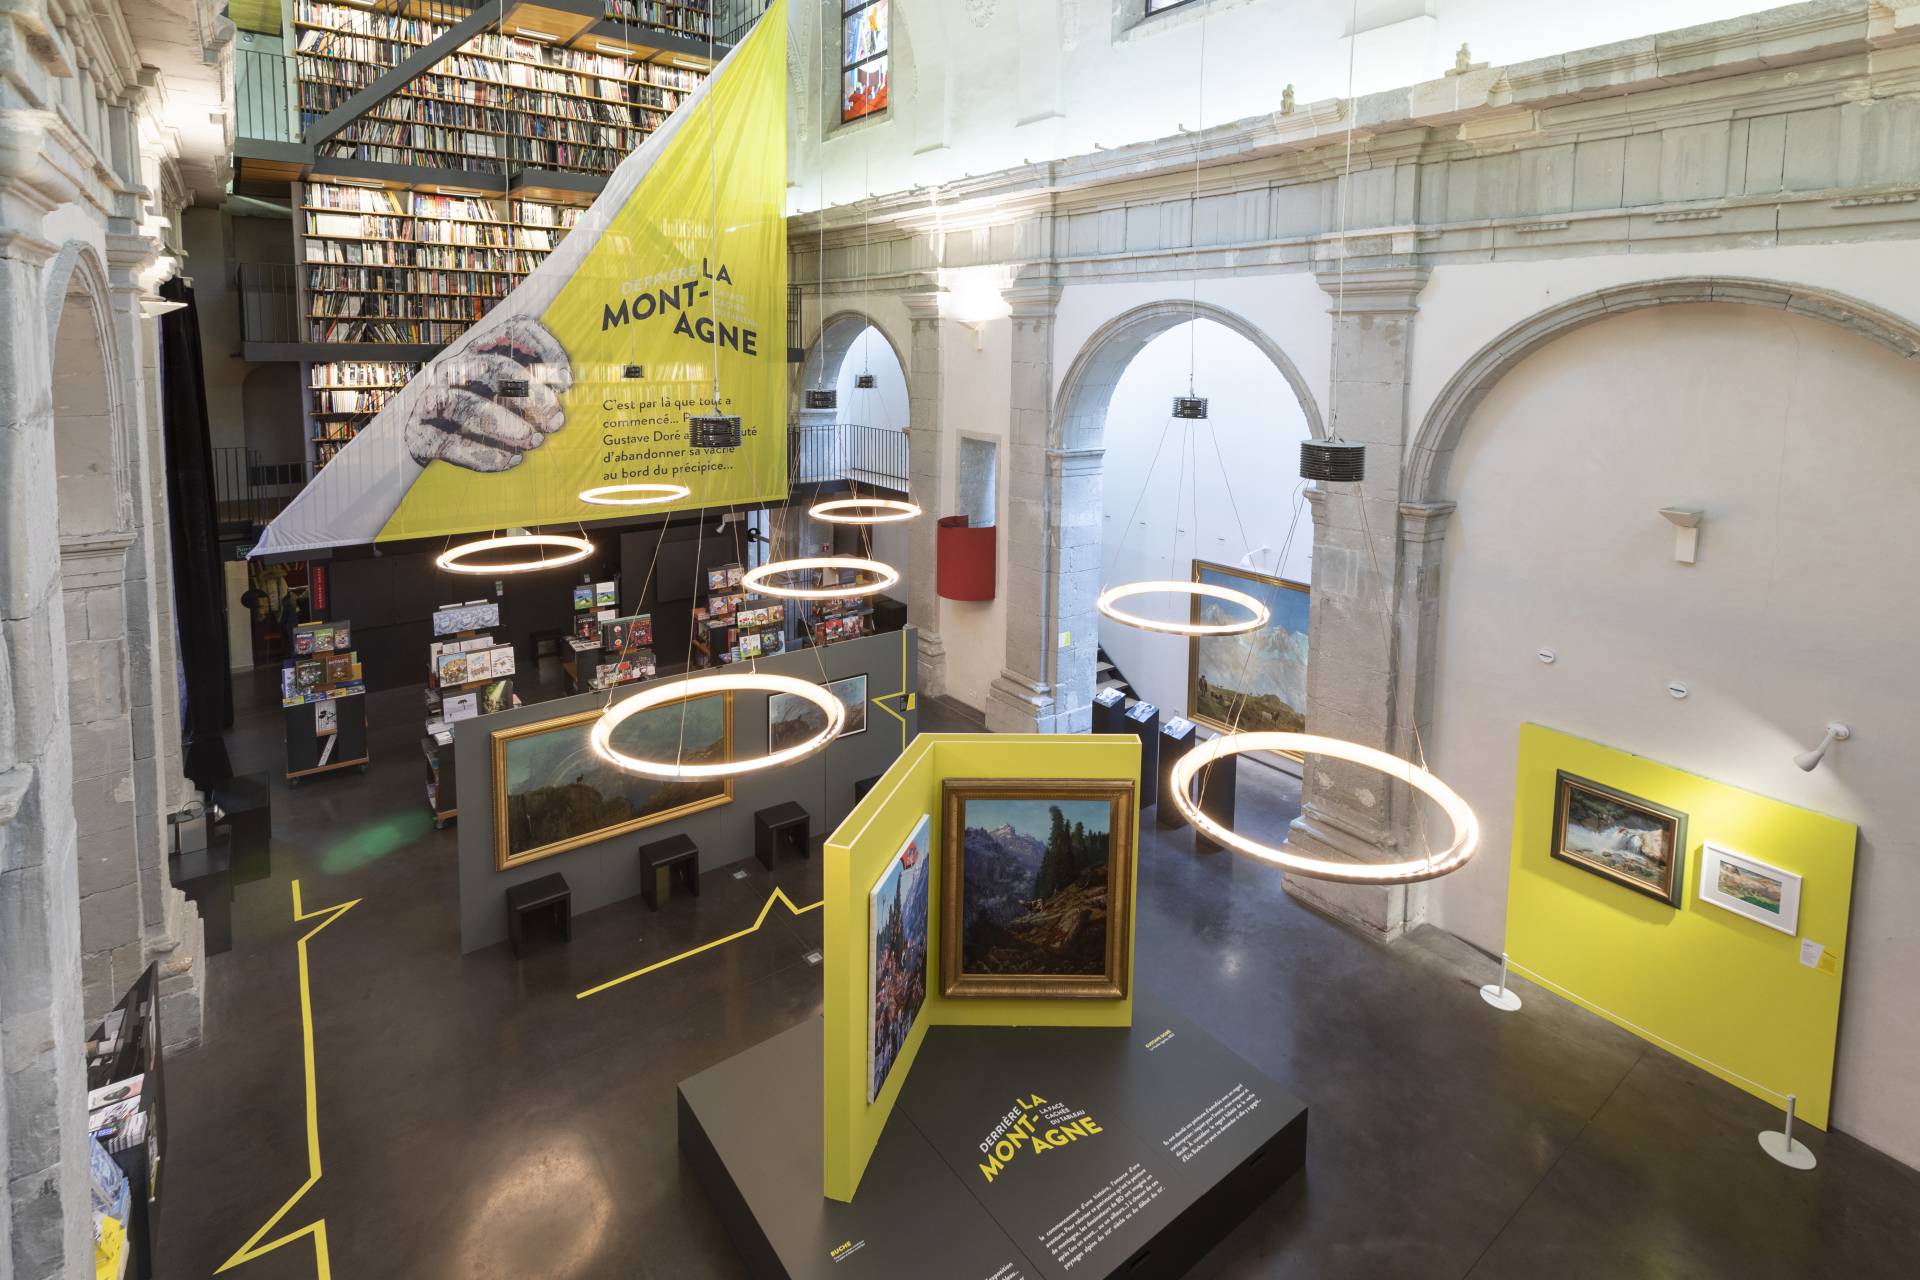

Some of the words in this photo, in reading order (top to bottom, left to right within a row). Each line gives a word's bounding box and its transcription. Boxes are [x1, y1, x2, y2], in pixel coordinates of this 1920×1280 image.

[703, 258, 732, 286] LA
[602, 280, 709, 331] MONT-
[673, 311, 757, 356] AGNE
[603, 399, 635, 410] C'est
[640, 402, 657, 412] par
[661, 397, 671, 408] là
[674, 400, 695, 410] que
[700, 398, 722, 406] tout
[602, 416, 679, 428] commencé...
[602, 434, 650, 446] Gustave
[653, 431, 680, 442] Doré
[603, 449, 684, 463] d'abandonner
[603, 472, 617, 480] au
[621, 466, 650, 478] bord
[653, 465, 668, 475] du
[672, 461, 733, 477] précipice...
[1016, 1094, 1048, 1110] LA
[1048, 1102, 1065, 1112] FACE
[1059, 1109, 1086, 1122] TABLEAU
[979, 1106, 1022, 1153] DERRIÈRE
[1032, 1116, 1103, 1154] AGNE
[978, 1114, 1039, 1183] MONT-
